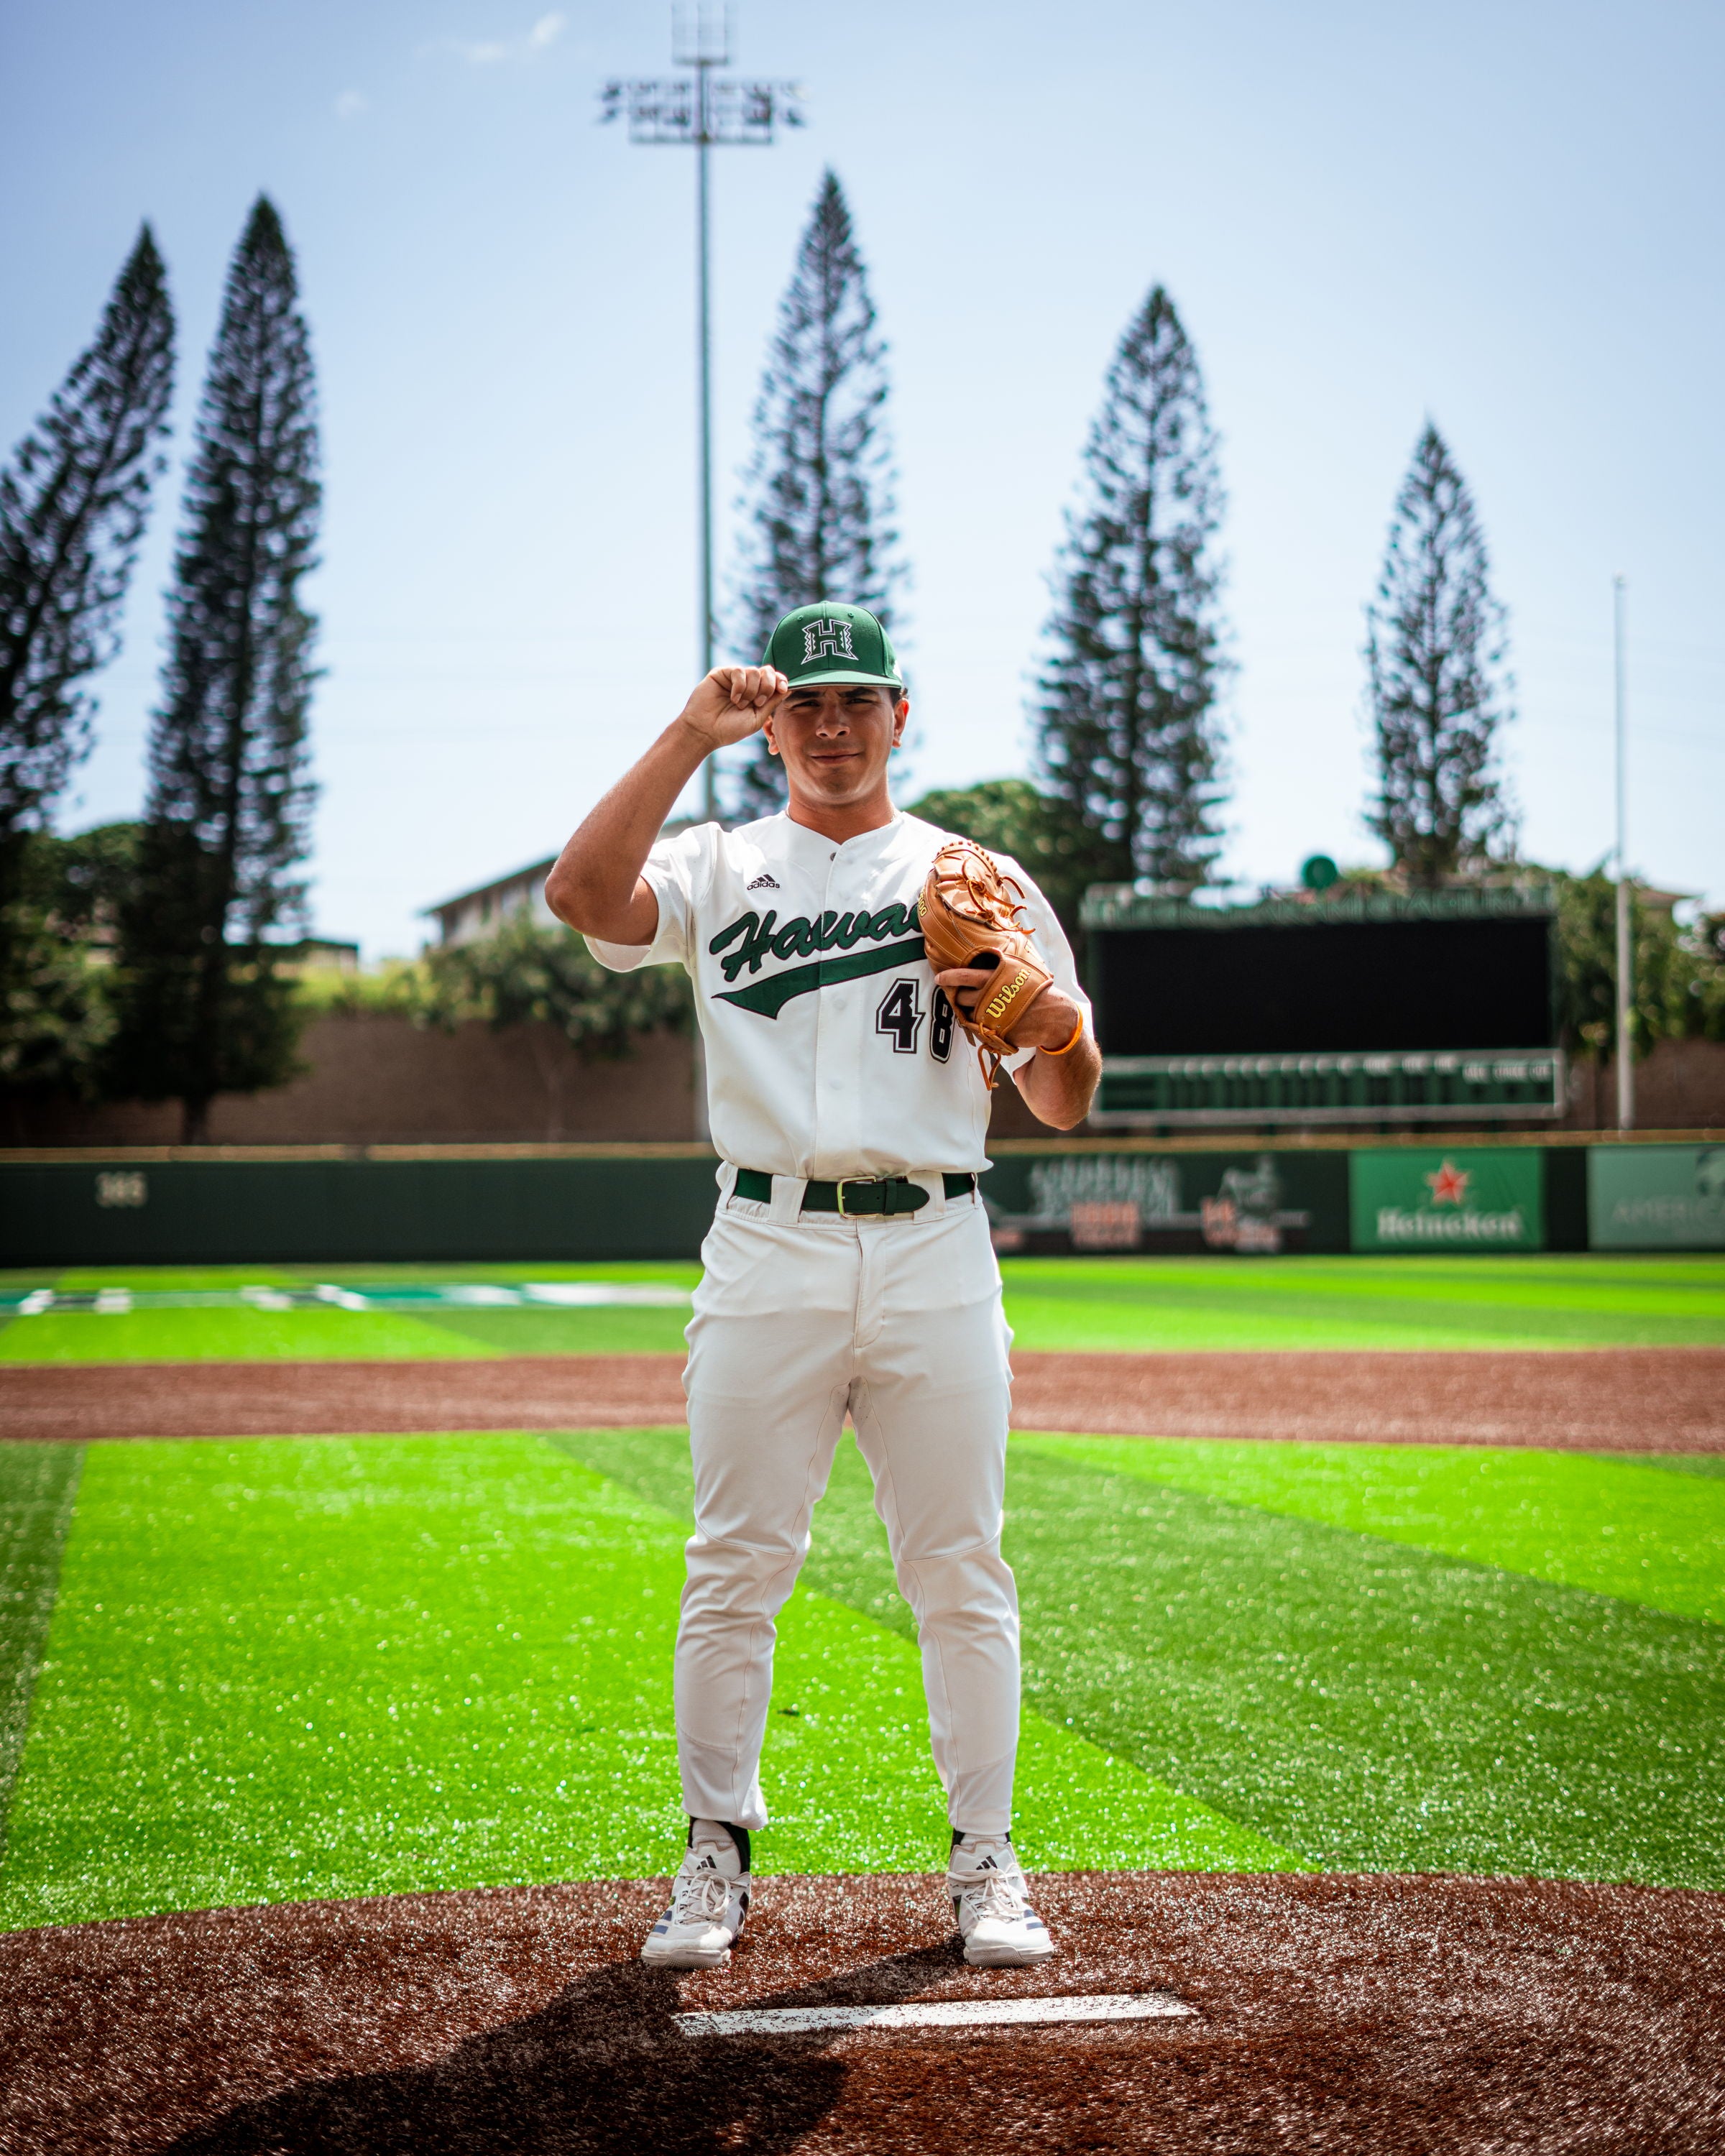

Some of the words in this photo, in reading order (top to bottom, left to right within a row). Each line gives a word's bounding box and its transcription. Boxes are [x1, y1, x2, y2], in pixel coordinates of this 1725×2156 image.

[801, 618, 859, 665] H
[747, 881, 781, 890] adidas
[985, 968, 1031, 1019] Wilson
[876, 977, 956, 1064] 48
